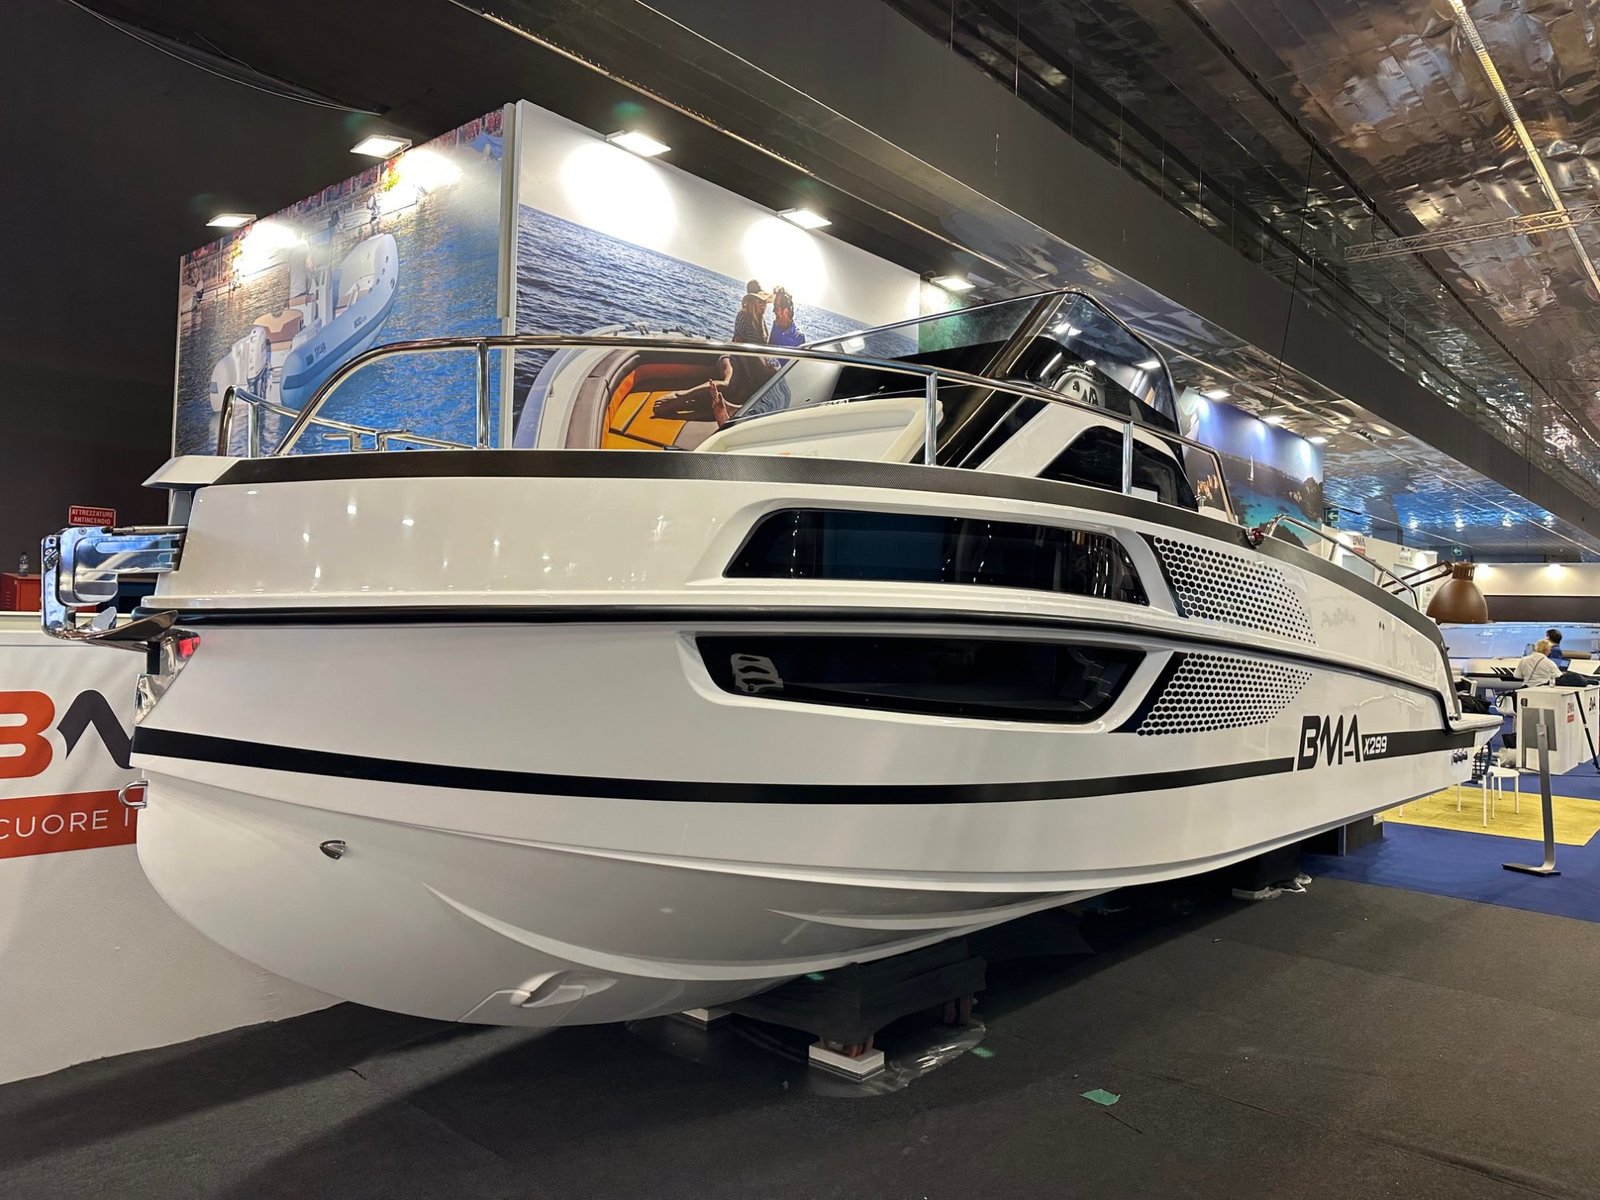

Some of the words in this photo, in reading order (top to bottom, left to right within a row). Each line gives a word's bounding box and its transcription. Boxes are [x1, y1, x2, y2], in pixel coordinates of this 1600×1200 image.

[71, 509, 114, 518] ATTREZZATURE
[73, 516, 111, 525] ANTINCENDIO
[1297, 714, 1361, 771] BMA
[1364, 736, 1387, 755] X299
